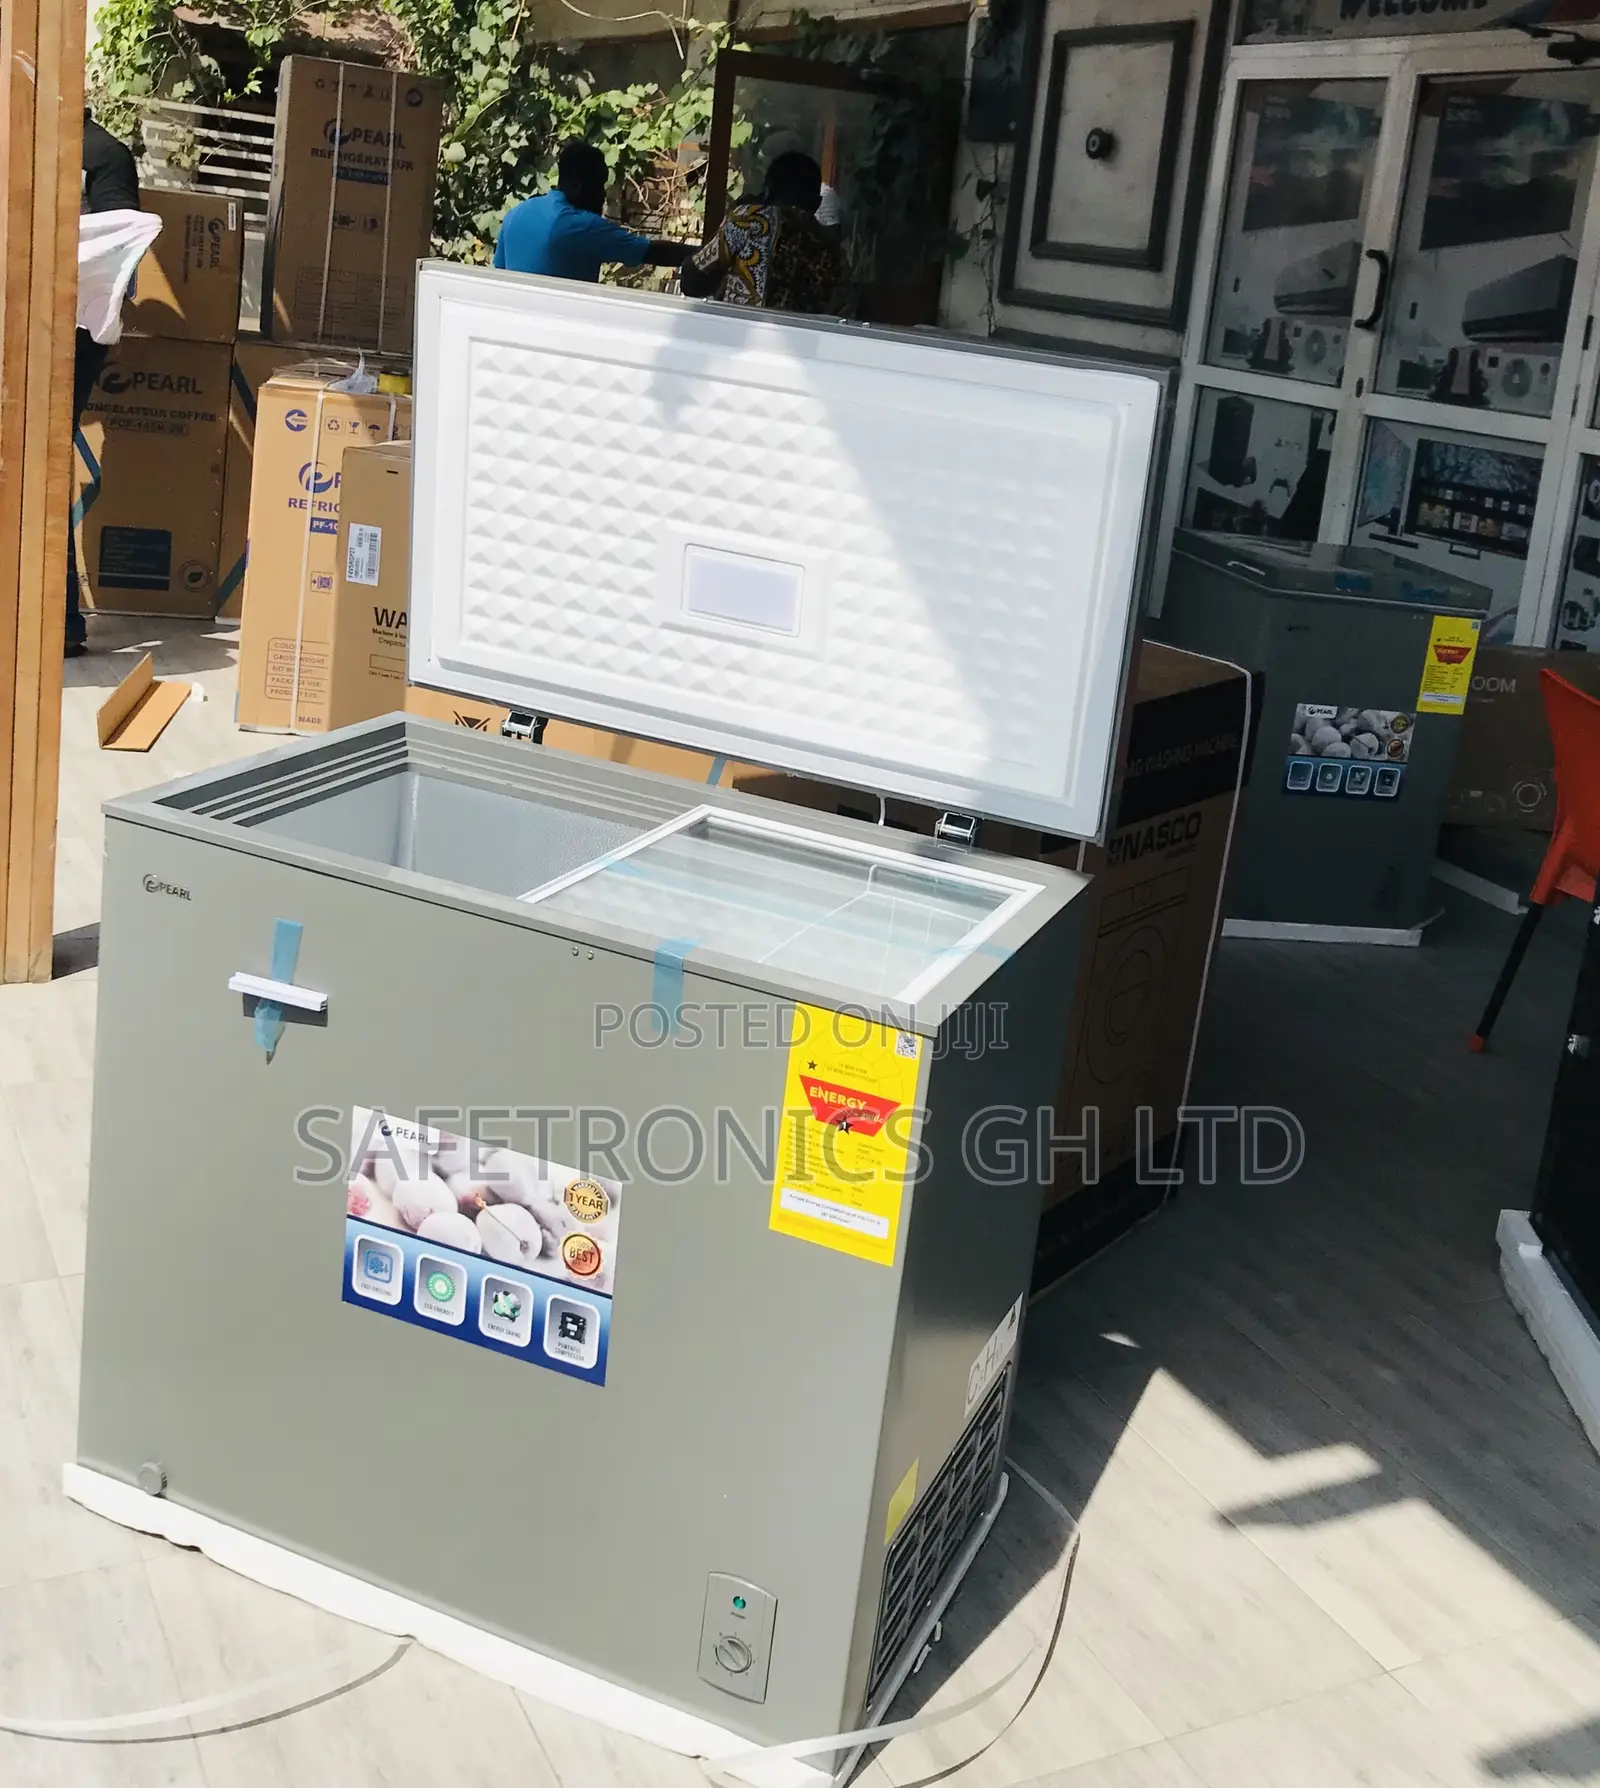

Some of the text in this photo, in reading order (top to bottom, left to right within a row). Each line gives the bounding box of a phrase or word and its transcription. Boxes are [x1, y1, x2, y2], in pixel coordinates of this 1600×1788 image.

[132, 372, 203, 395] PEARL
[87, 402, 217, 422] ONGELATEUR COFFRE
[373, 606, 407, 629] WA
[270, 688, 302, 696] PRODUT
[298, 716, 321, 724] MADE
[1122, 811, 1202, 862] NASCO
[159, 881, 192, 901] PEARL
[809, 1085, 867, 1110] ENERGY
[396, 1127, 431, 1146] PEARL
[569, 1192, 603, 1211] 1 YEAR
[569, 1246, 594, 1264] BEST
